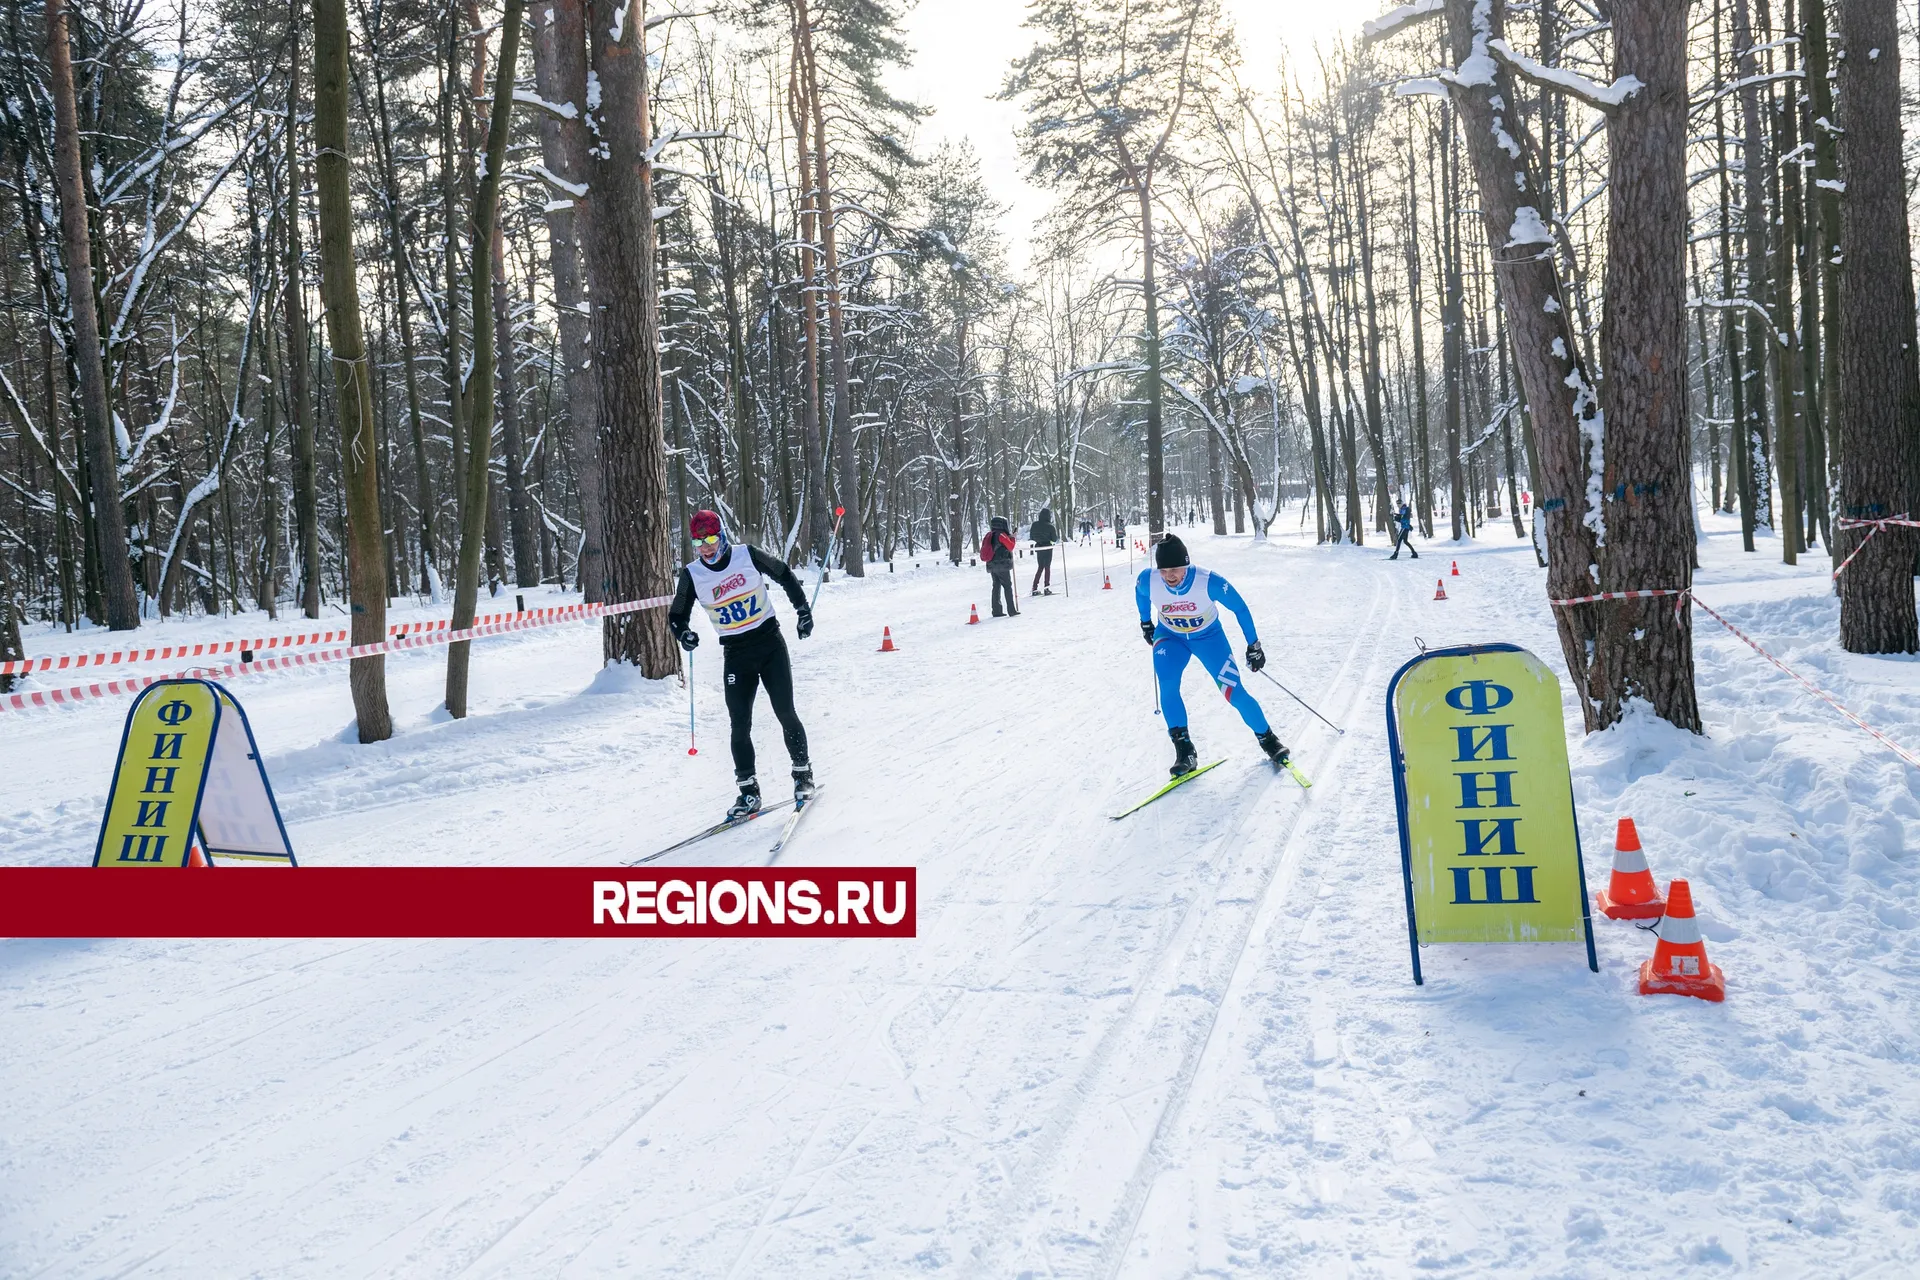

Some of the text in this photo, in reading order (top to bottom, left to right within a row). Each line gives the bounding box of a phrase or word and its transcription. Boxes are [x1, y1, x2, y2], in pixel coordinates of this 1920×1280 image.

[714, 594, 762, 625] 382
[116, 700, 193, 862] ФИНИШ
[1445, 679, 1541, 905] ФИНИШ
